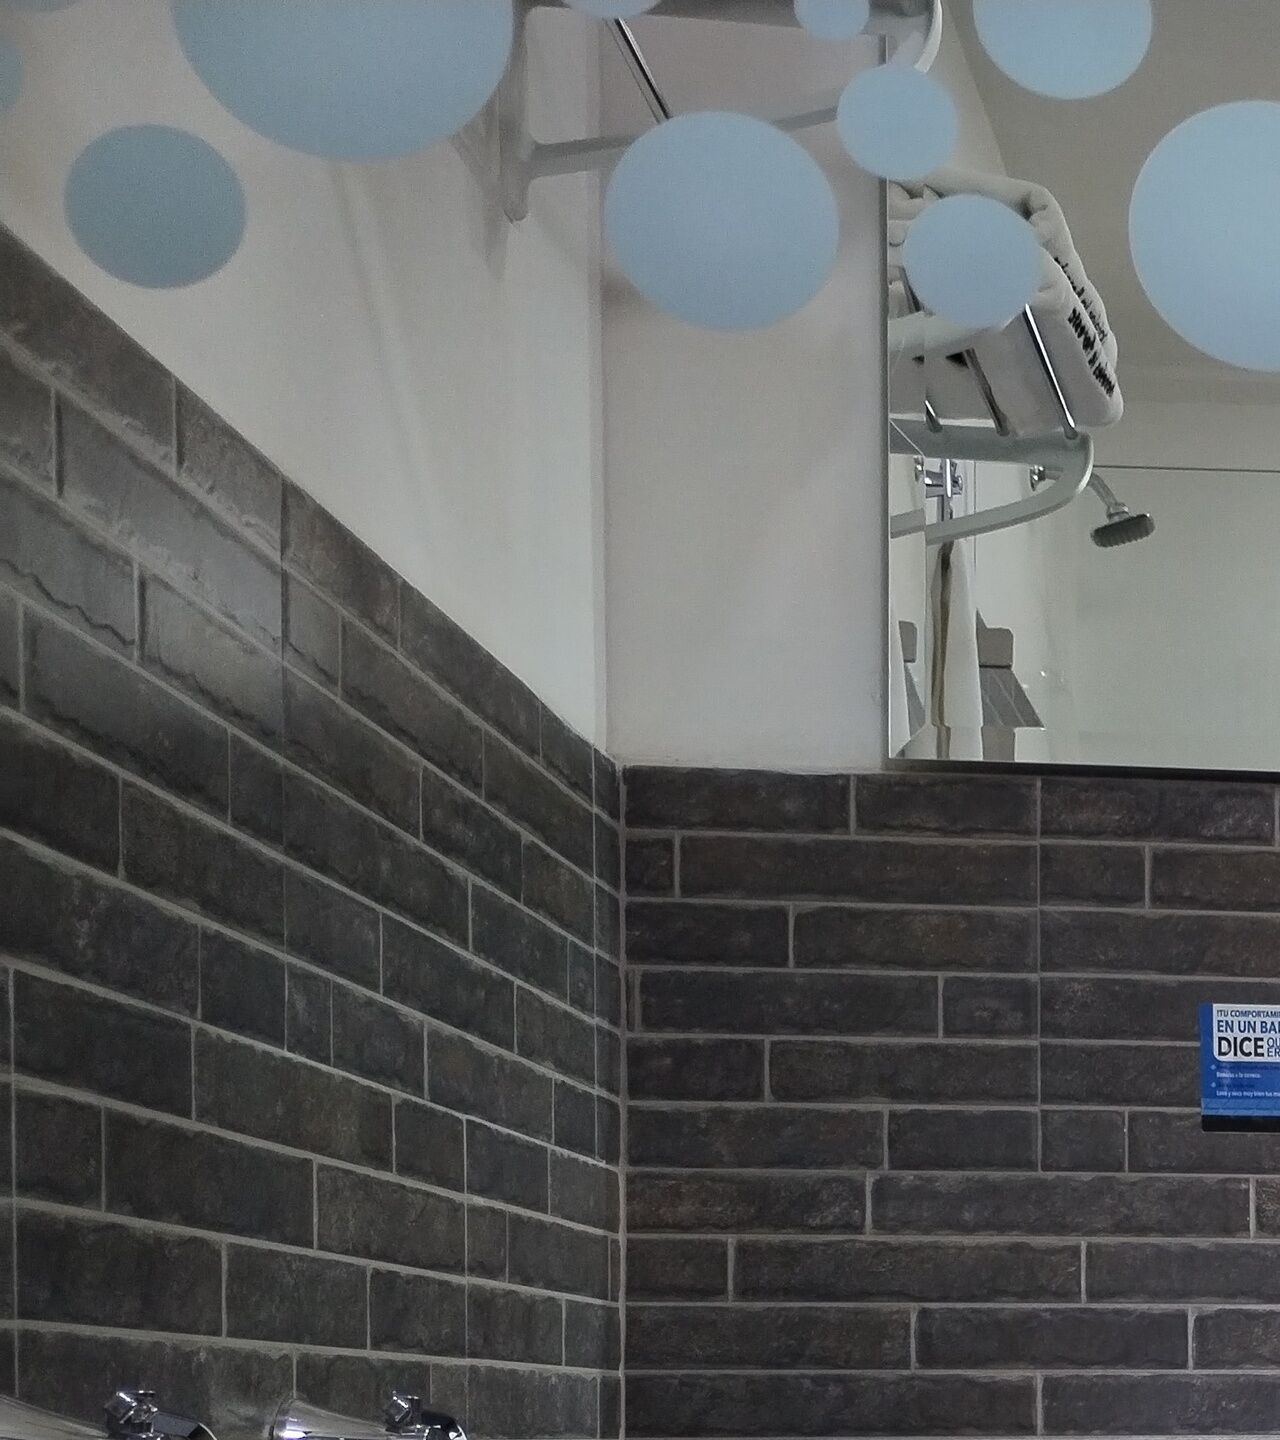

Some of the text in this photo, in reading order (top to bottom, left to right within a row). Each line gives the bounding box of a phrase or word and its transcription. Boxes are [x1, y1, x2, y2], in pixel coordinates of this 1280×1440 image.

[1217, 1020, 1234, 1033] EN
[1238, 1020, 1256, 1034] UN
[1217, 1036, 1265, 1057] DICE
